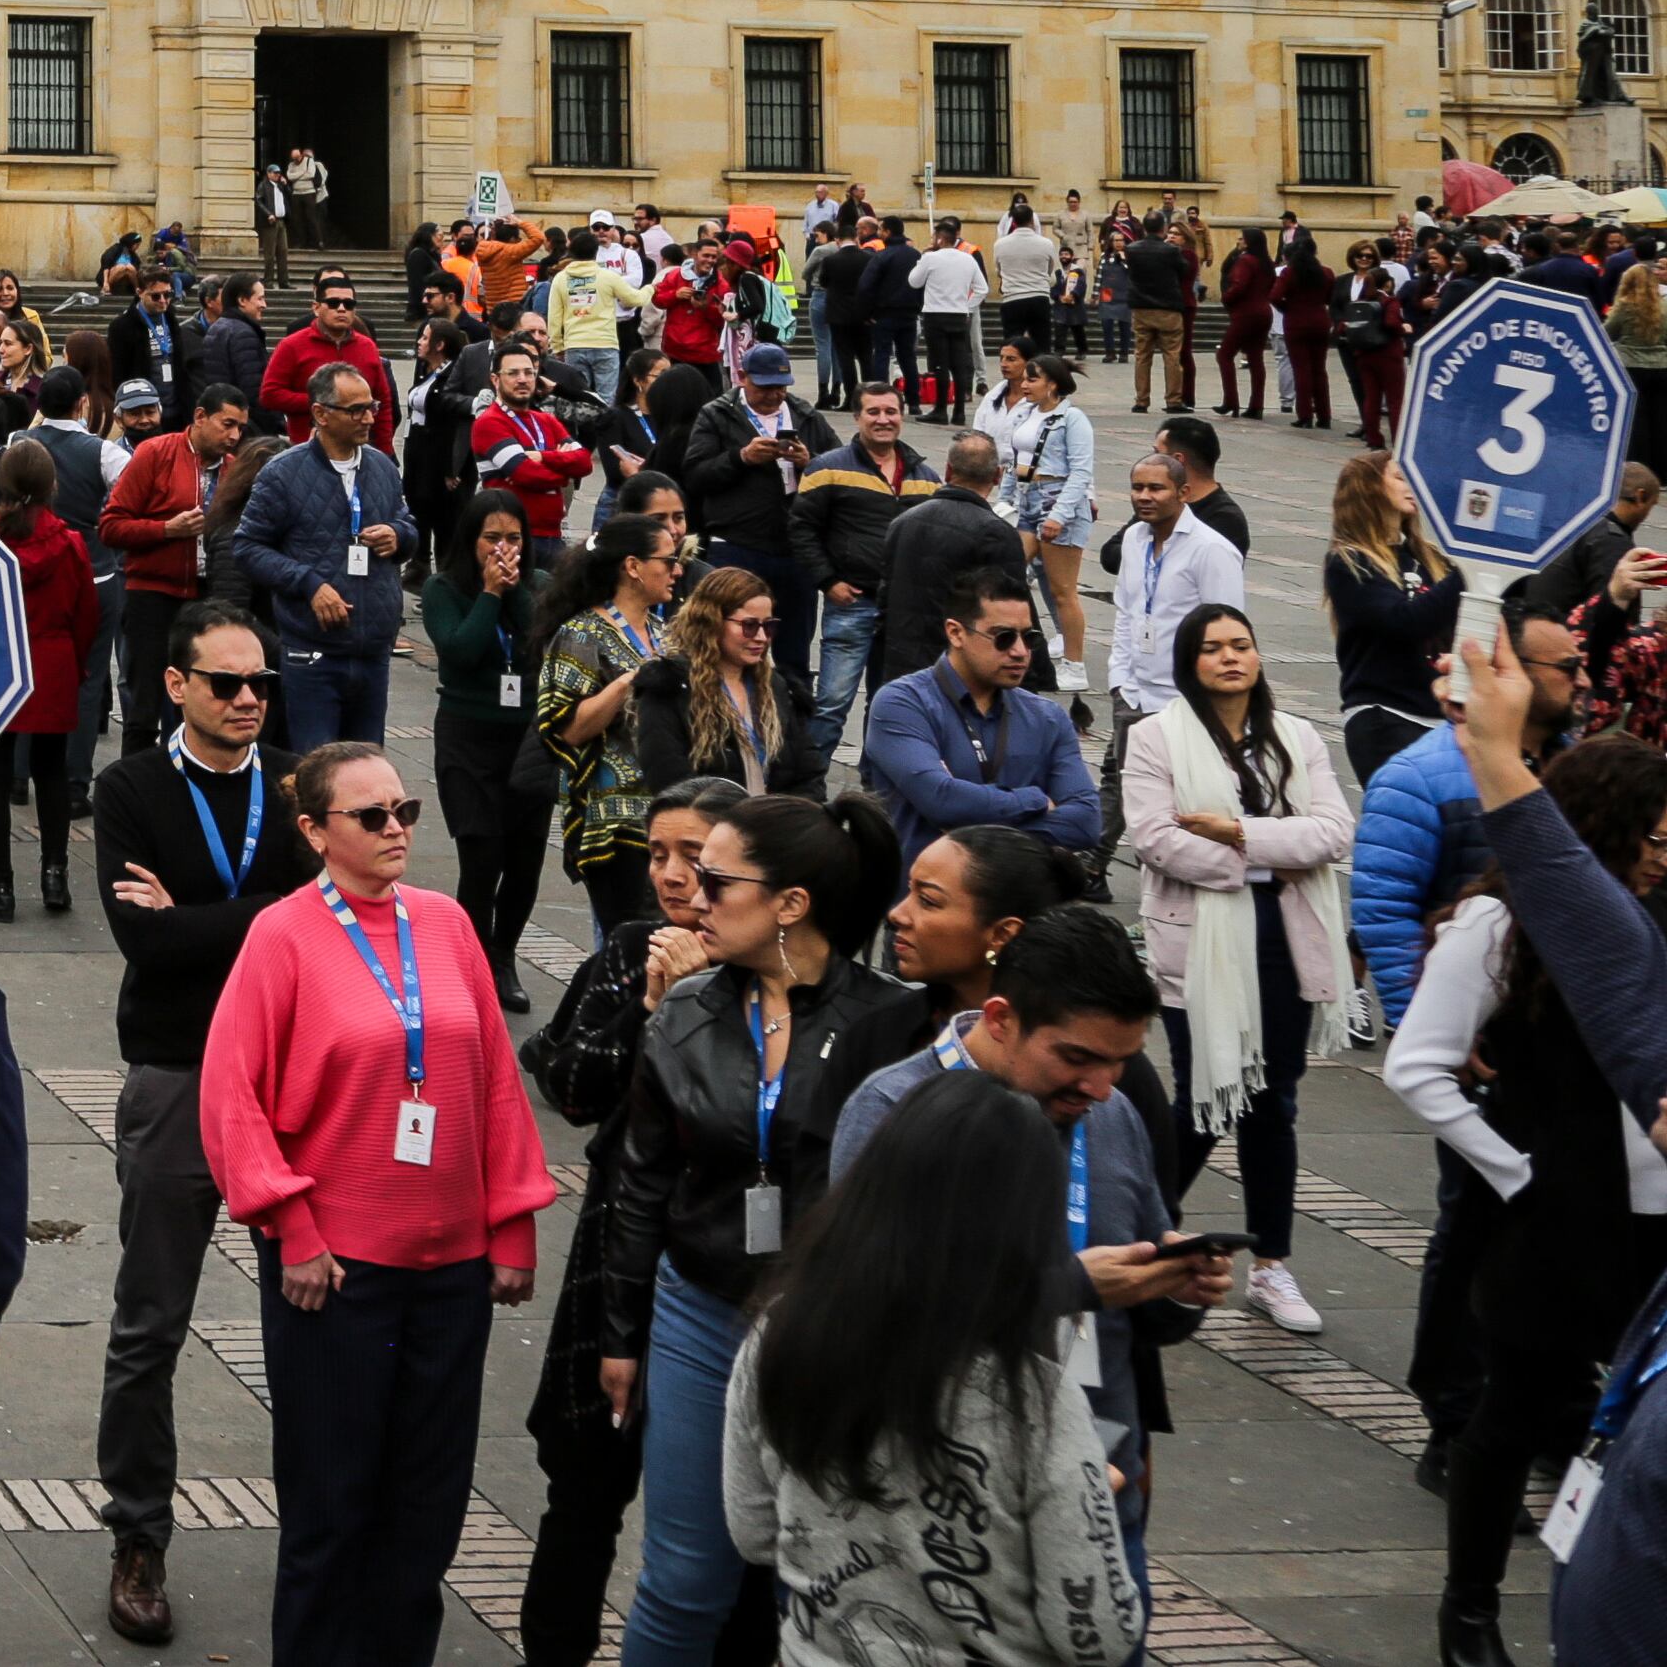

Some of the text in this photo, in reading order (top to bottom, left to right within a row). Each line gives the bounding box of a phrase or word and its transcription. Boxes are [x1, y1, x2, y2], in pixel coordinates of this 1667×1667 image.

[1427, 319, 1611, 432] PUNTO DE ENCUENTRO
[1476, 364, 1556, 475] 3
